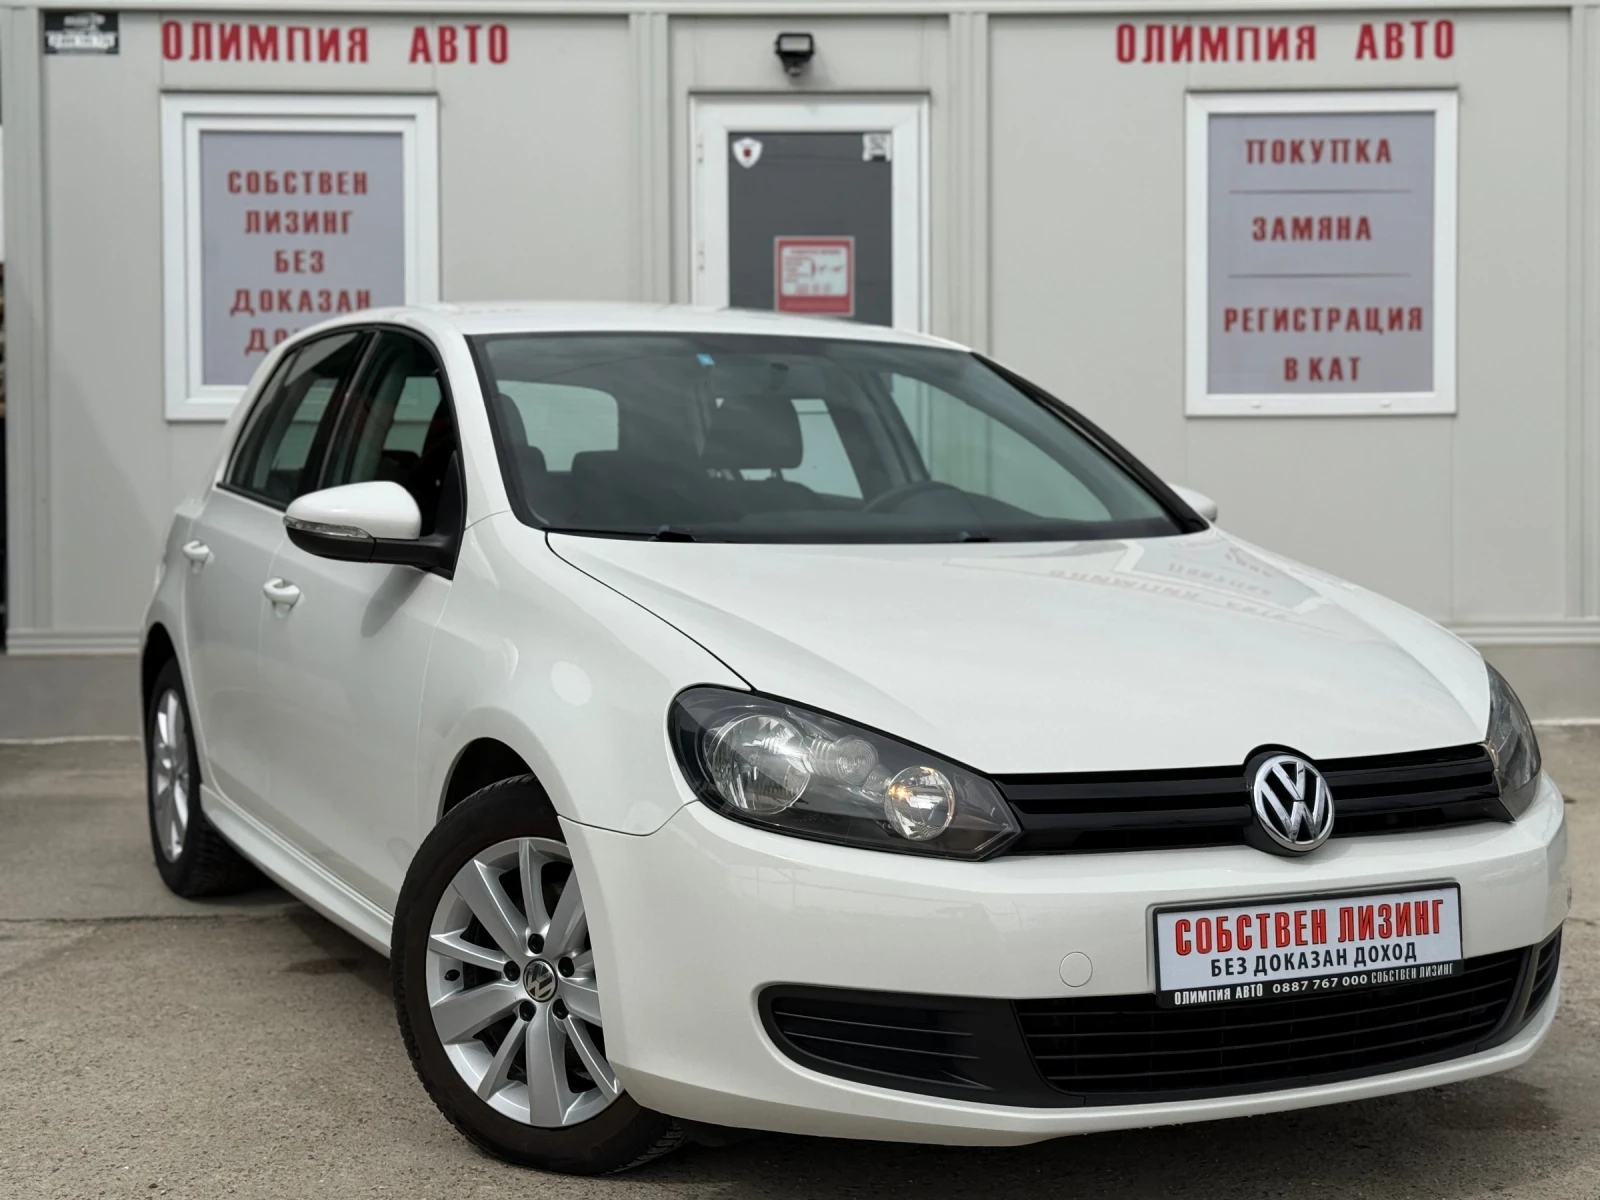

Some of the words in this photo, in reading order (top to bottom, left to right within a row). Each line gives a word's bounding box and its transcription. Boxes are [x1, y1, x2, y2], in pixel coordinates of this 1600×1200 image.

[160, 20, 369, 64] ОЛИМПИЯ
[408, 23, 509, 65] АВТО
[1115, 22, 1317, 64] ОЛИМПИЯ
[1354, 18, 1455, 61] АВТО
[1246, 139, 1392, 164] ПОКУПКА
[227, 171, 368, 195] СОБСТВЕН
[244, 210, 354, 235] ЛИЗИНГ
[1252, 216, 1372, 241] ЗАМЯНА
[274, 251, 325, 274] БЕЗ
[230, 290, 372, 316] ДОКАЗАН
[1223, 306, 1423, 334] РЕГИСТРАЦИЯ
[1283, 358, 1298, 381] В
[1309, 357, 1361, 381] КАТ
[1174, 909, 1328, 956] СОБСТВЕН
[1338, 899, 1444, 943] ЛИЗИНГ
[1211, 957, 1248, 977] БЕЗ
[1253, 948, 1348, 977] ДОКАЗАН
[1353, 942, 1417, 968] ДОХОД
[1174, 988, 1231, 1006] ОЛИМПИЯ
[1235, 983, 1264, 999] АВТО
[1272, 980, 1309, 994] 0887
[1312, 978, 1339, 990] 767
[1342, 974, 1369, 987] 000
[1371, 967, 1417, 984] СОБСТВЕН
[1419, 963, 1454, 979] ЛИЗИНГ
